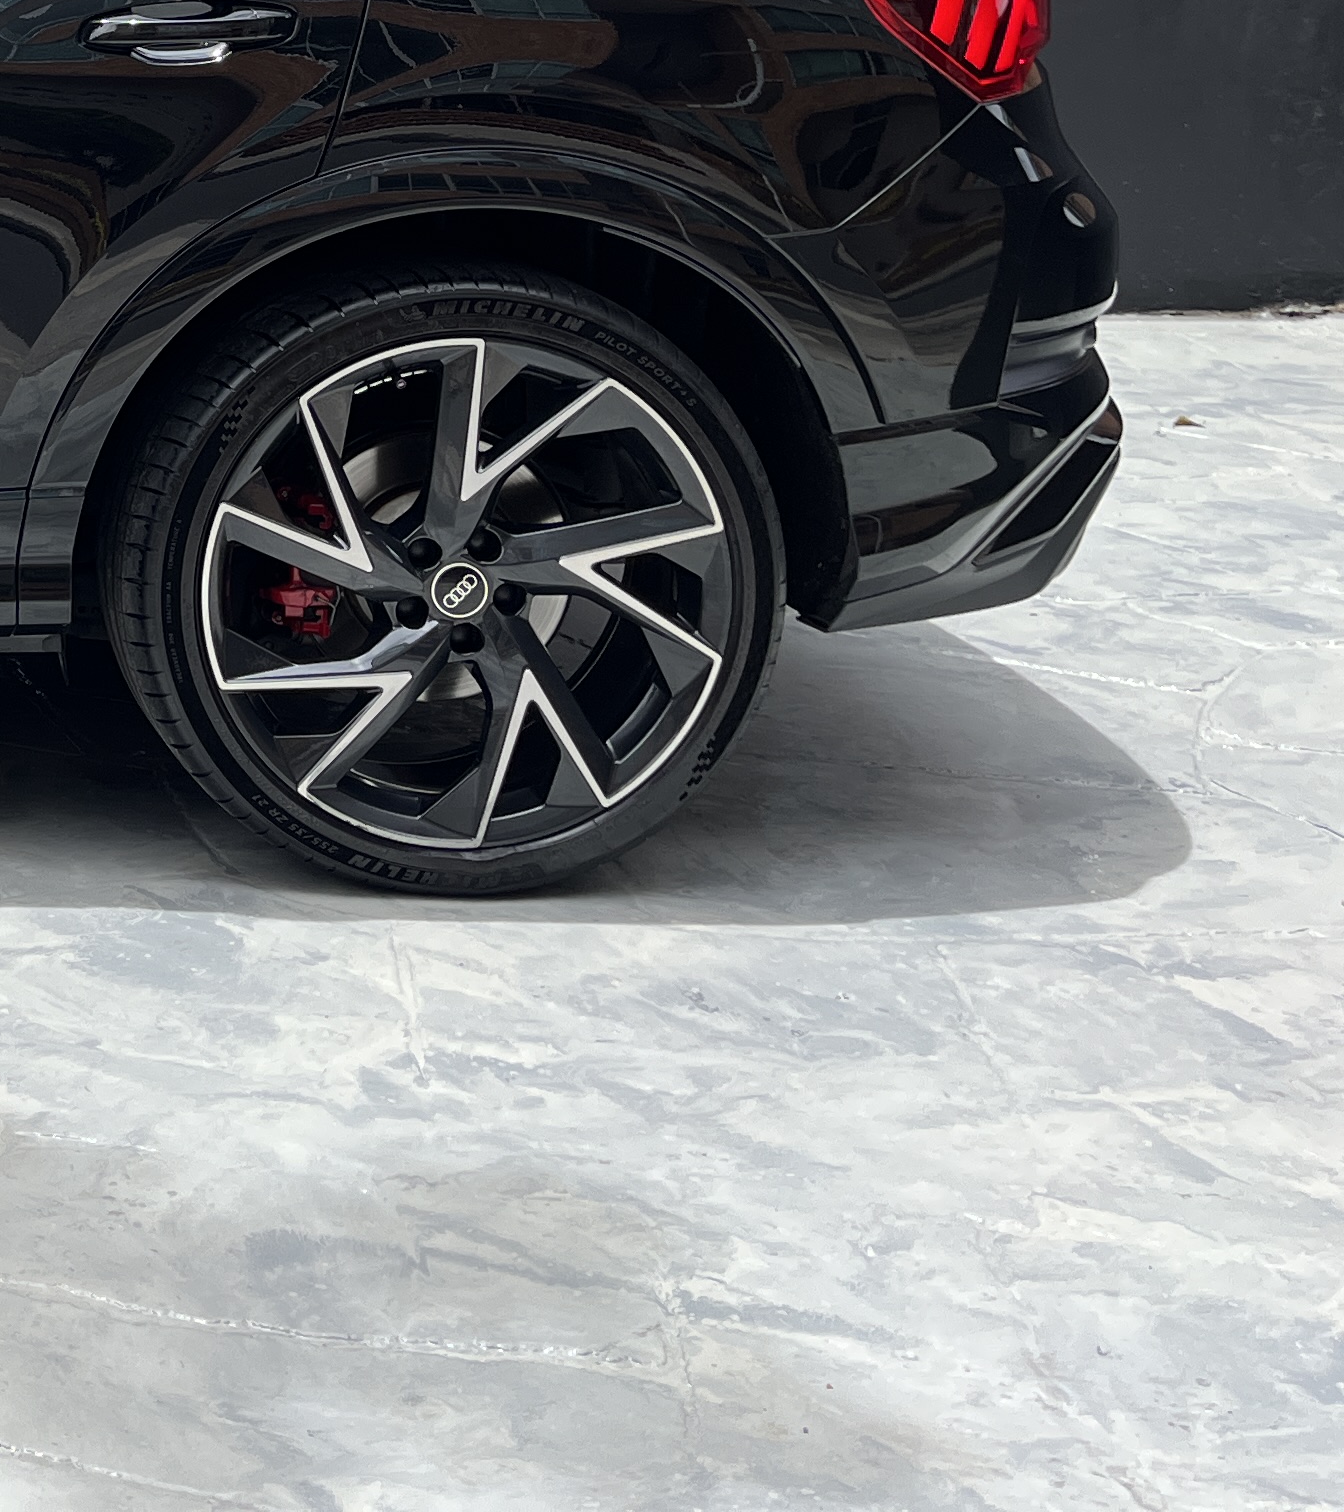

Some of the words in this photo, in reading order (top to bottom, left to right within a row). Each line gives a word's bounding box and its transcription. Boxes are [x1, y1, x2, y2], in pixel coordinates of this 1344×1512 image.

[432, 299, 586, 332] MICHELIN
[594, 330, 638, 356] PILOT
[251, 793, 270, 807] 21
[267, 807, 289, 824] ZR
